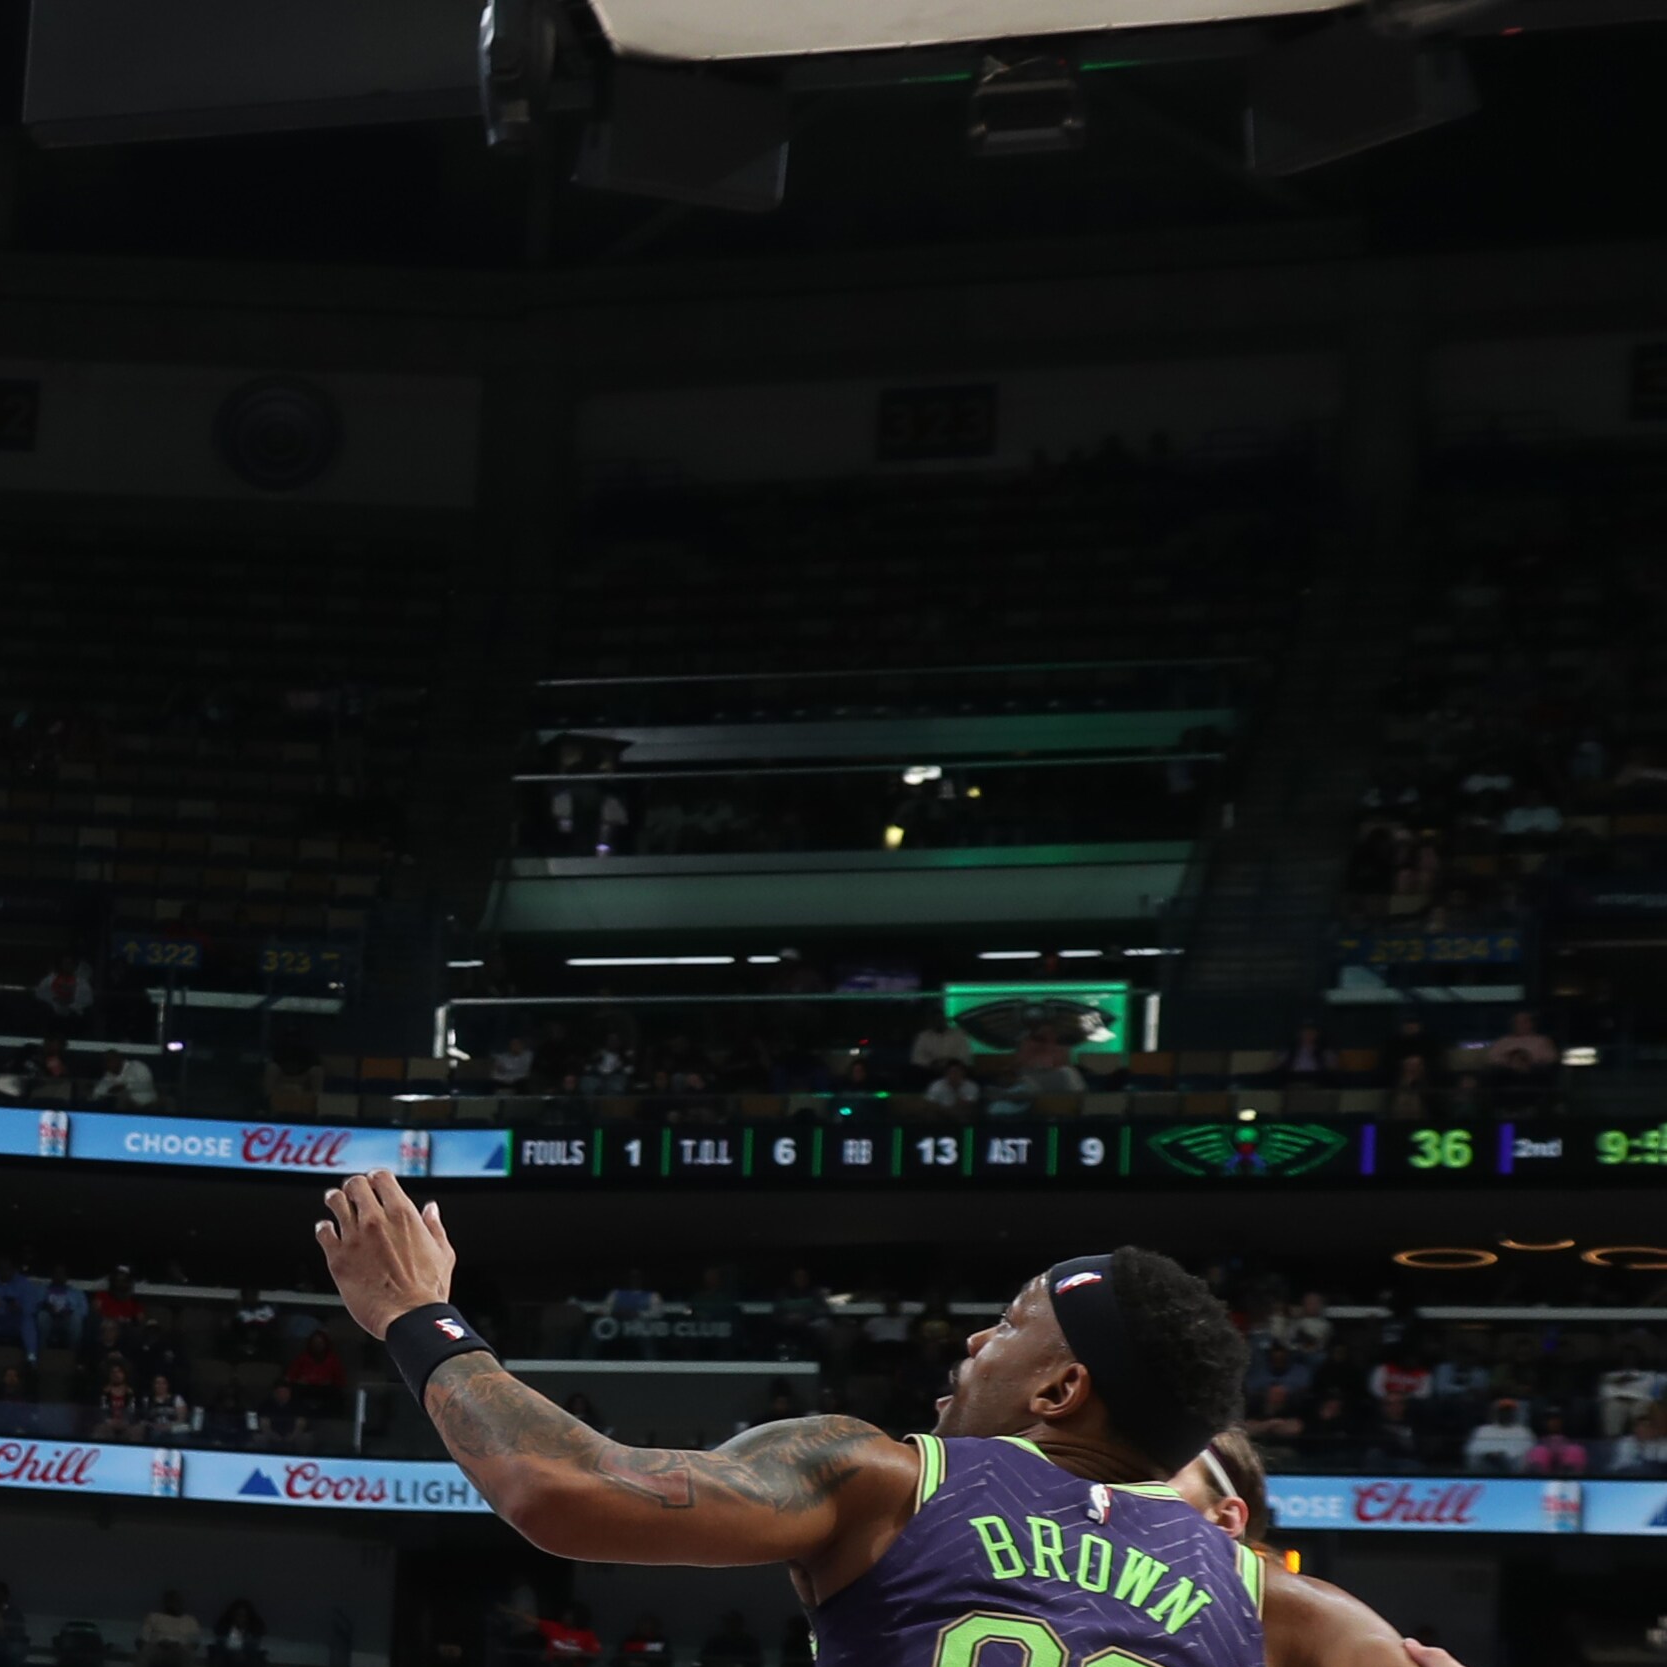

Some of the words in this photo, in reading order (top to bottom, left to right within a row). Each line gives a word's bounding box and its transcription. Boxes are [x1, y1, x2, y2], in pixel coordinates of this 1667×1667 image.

[123, 1130, 233, 1158] CHOOSE
[240, 1125, 353, 1168] Chill
[521, 1138, 586, 1166] FOULS
[625, 1139, 643, 1167] 1
[773, 1137, 797, 1166] 6
[916, 1137, 960, 1166] 13
[987, 1138, 1033, 1166] AST
[1079, 1137, 1106, 1166] 9
[1408, 1128, 1474, 1169] 36
[283, 1461, 387, 1505] Coors
[1353, 1482, 1483, 1525] Chill
[968, 1513, 1214, 1635] BROWN
